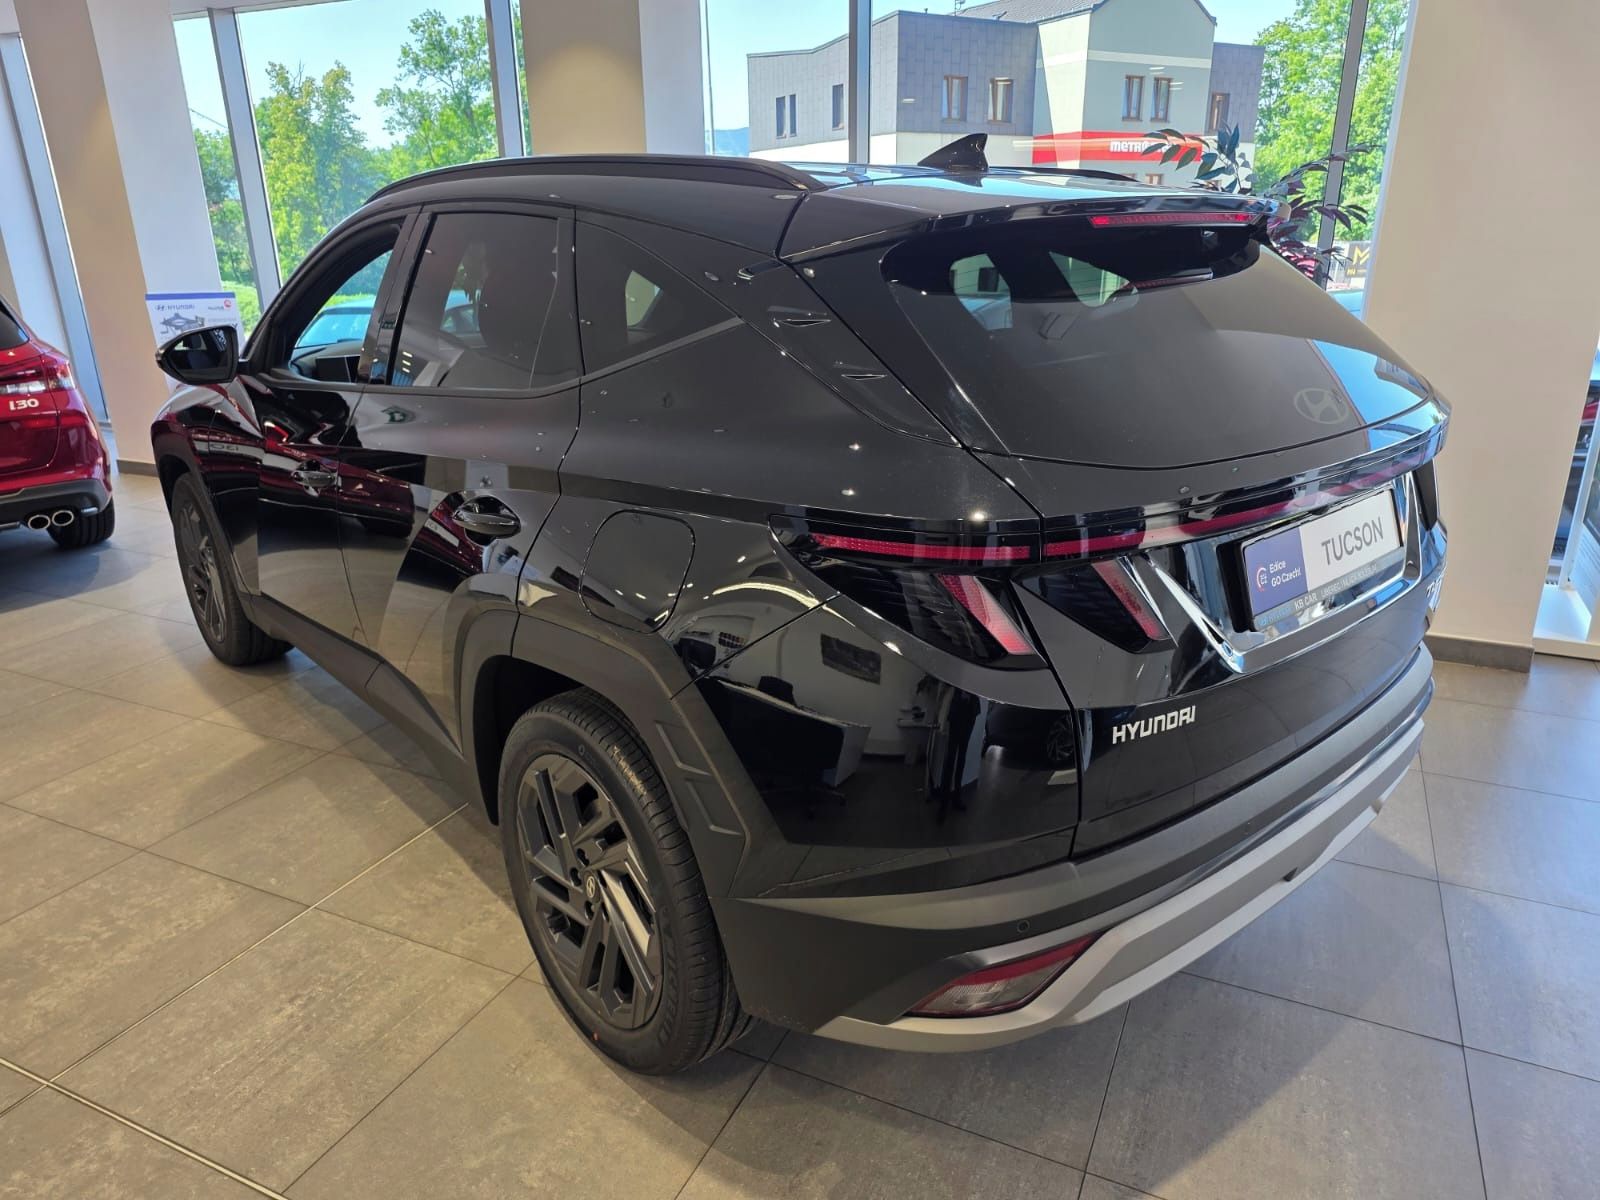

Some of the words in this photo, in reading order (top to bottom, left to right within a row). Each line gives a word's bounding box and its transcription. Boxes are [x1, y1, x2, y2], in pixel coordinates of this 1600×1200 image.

[1321, 517, 1383, 566] TUCSON
[1269, 560, 1286, 574] Edice
[1271, 575, 1282, 588] GO
[1304, 592, 1318, 606] CAR
[1112, 705, 1196, 745] HYUNDAI
